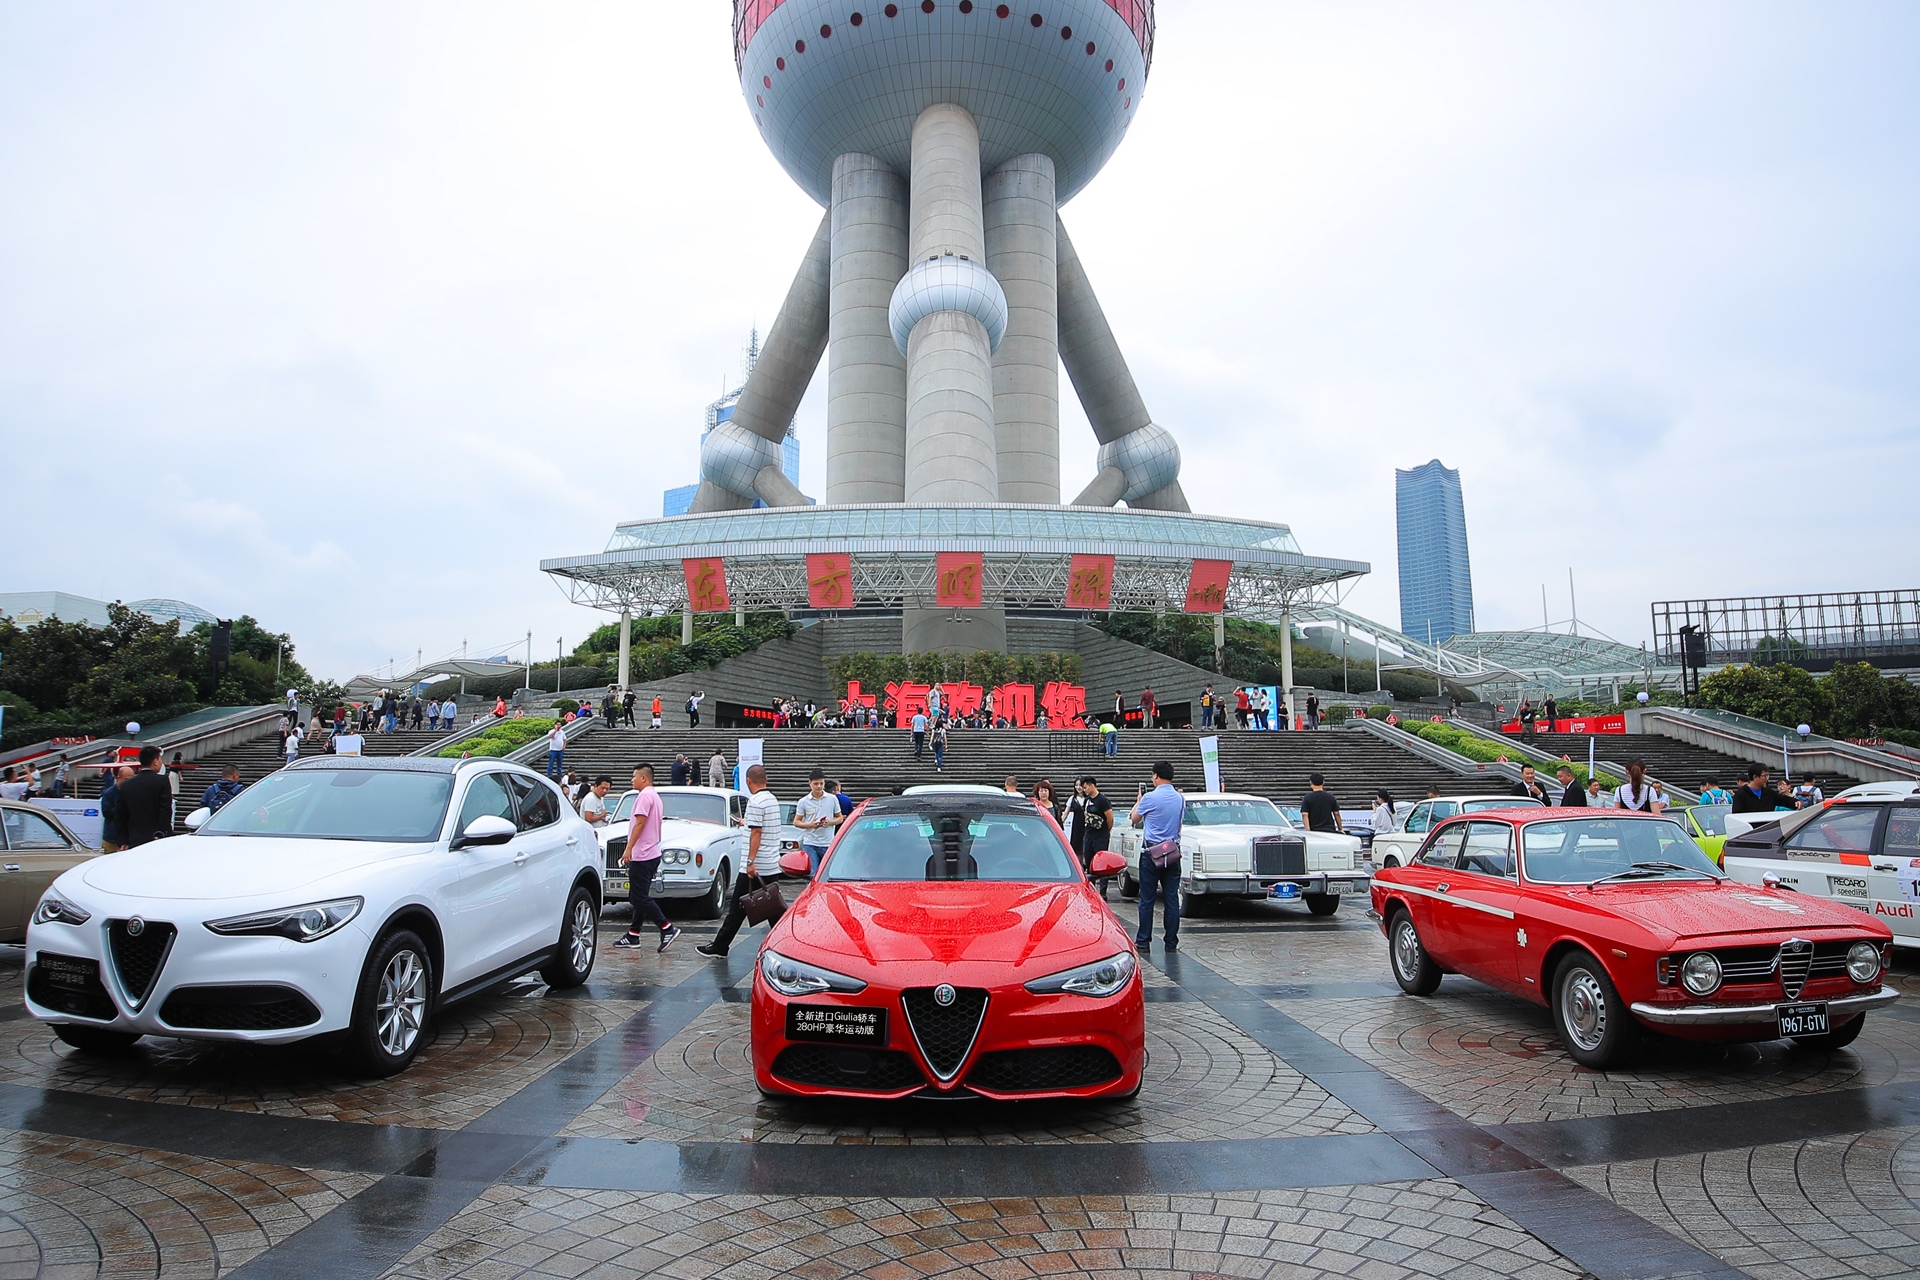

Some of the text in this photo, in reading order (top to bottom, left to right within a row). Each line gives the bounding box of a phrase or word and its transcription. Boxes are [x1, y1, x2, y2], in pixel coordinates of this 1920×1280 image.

[1834, 877, 1867, 888] RECARO
[1911, 880, 1920, 897] 1
[1837, 888, 1867, 897] speedline
[1875, 902, 1914, 918] Audi
[795, 1010, 877, 1023] 全新进口Giulia轿车
[1780, 1013, 1825, 1033] 1967-GTV
[796, 1021, 875, 1035] 280HP豪华运动版
